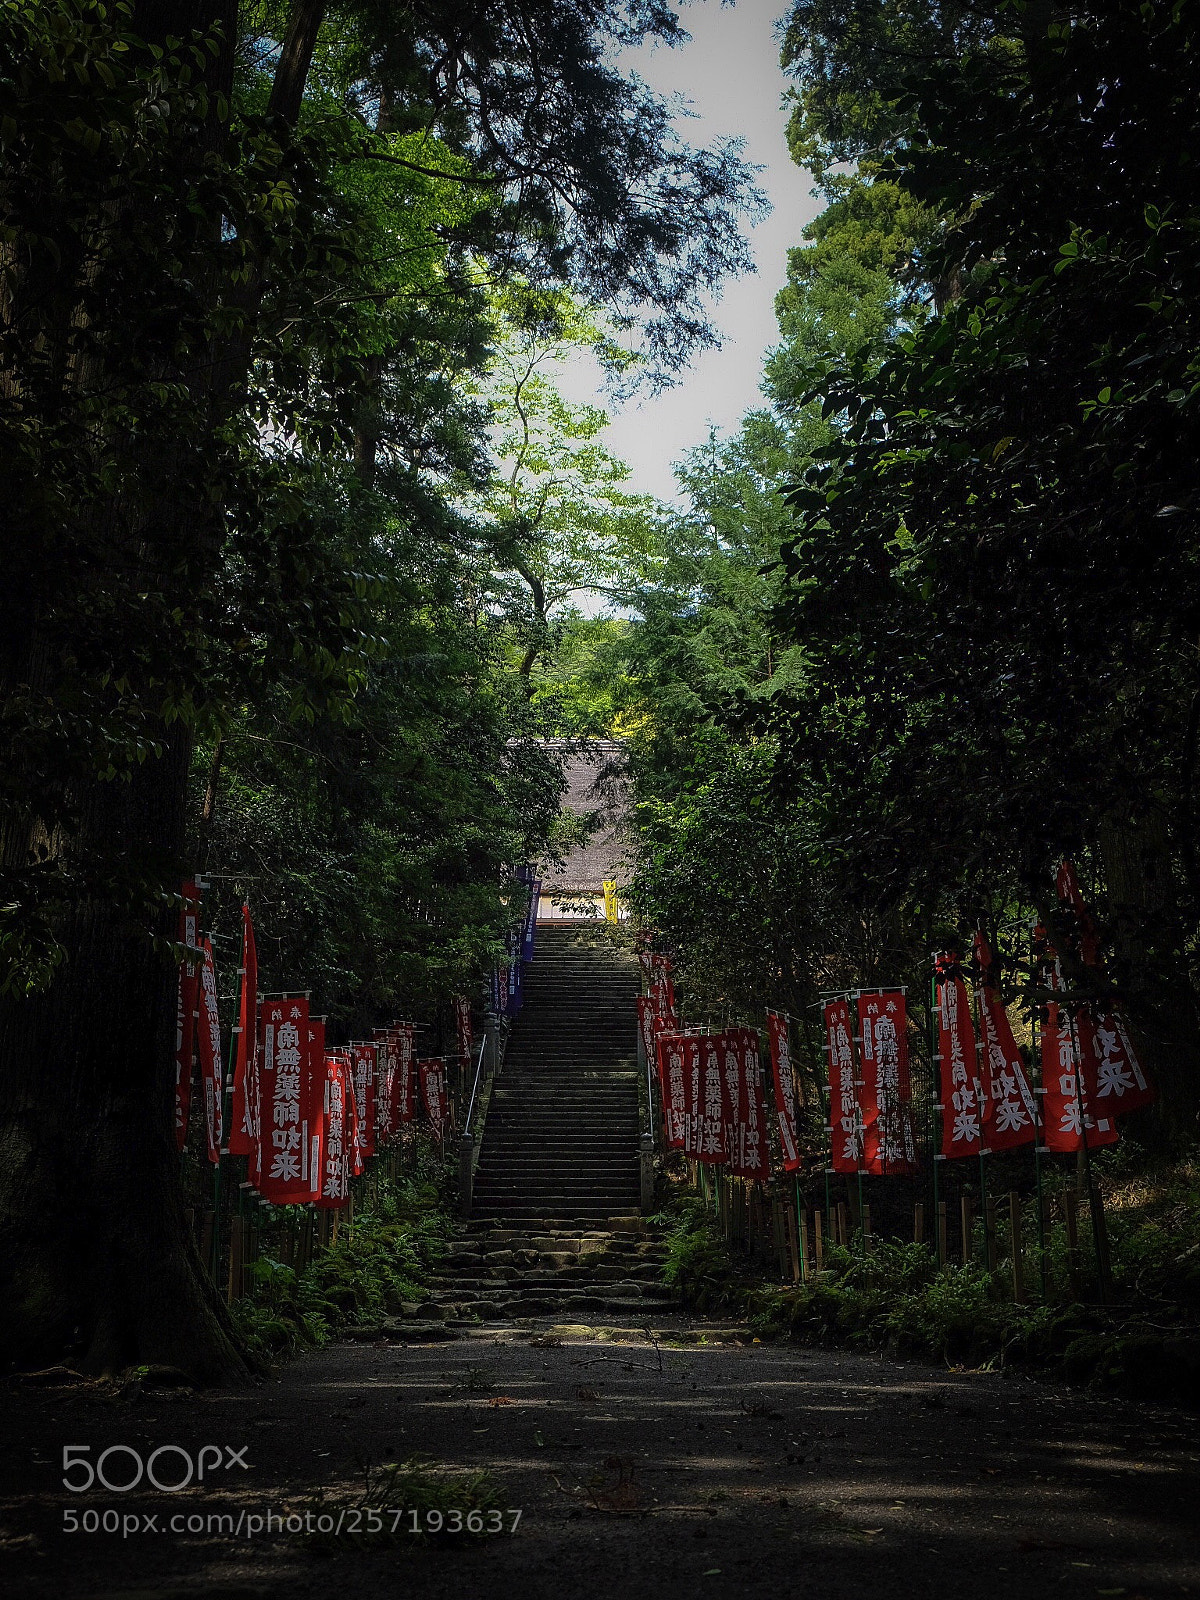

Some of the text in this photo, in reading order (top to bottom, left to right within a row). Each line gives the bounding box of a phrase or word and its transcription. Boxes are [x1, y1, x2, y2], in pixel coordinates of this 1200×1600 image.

[669, 1053, 685, 1140] 南無薬師如来
[703, 1051, 722, 1154] 南無薬師如来
